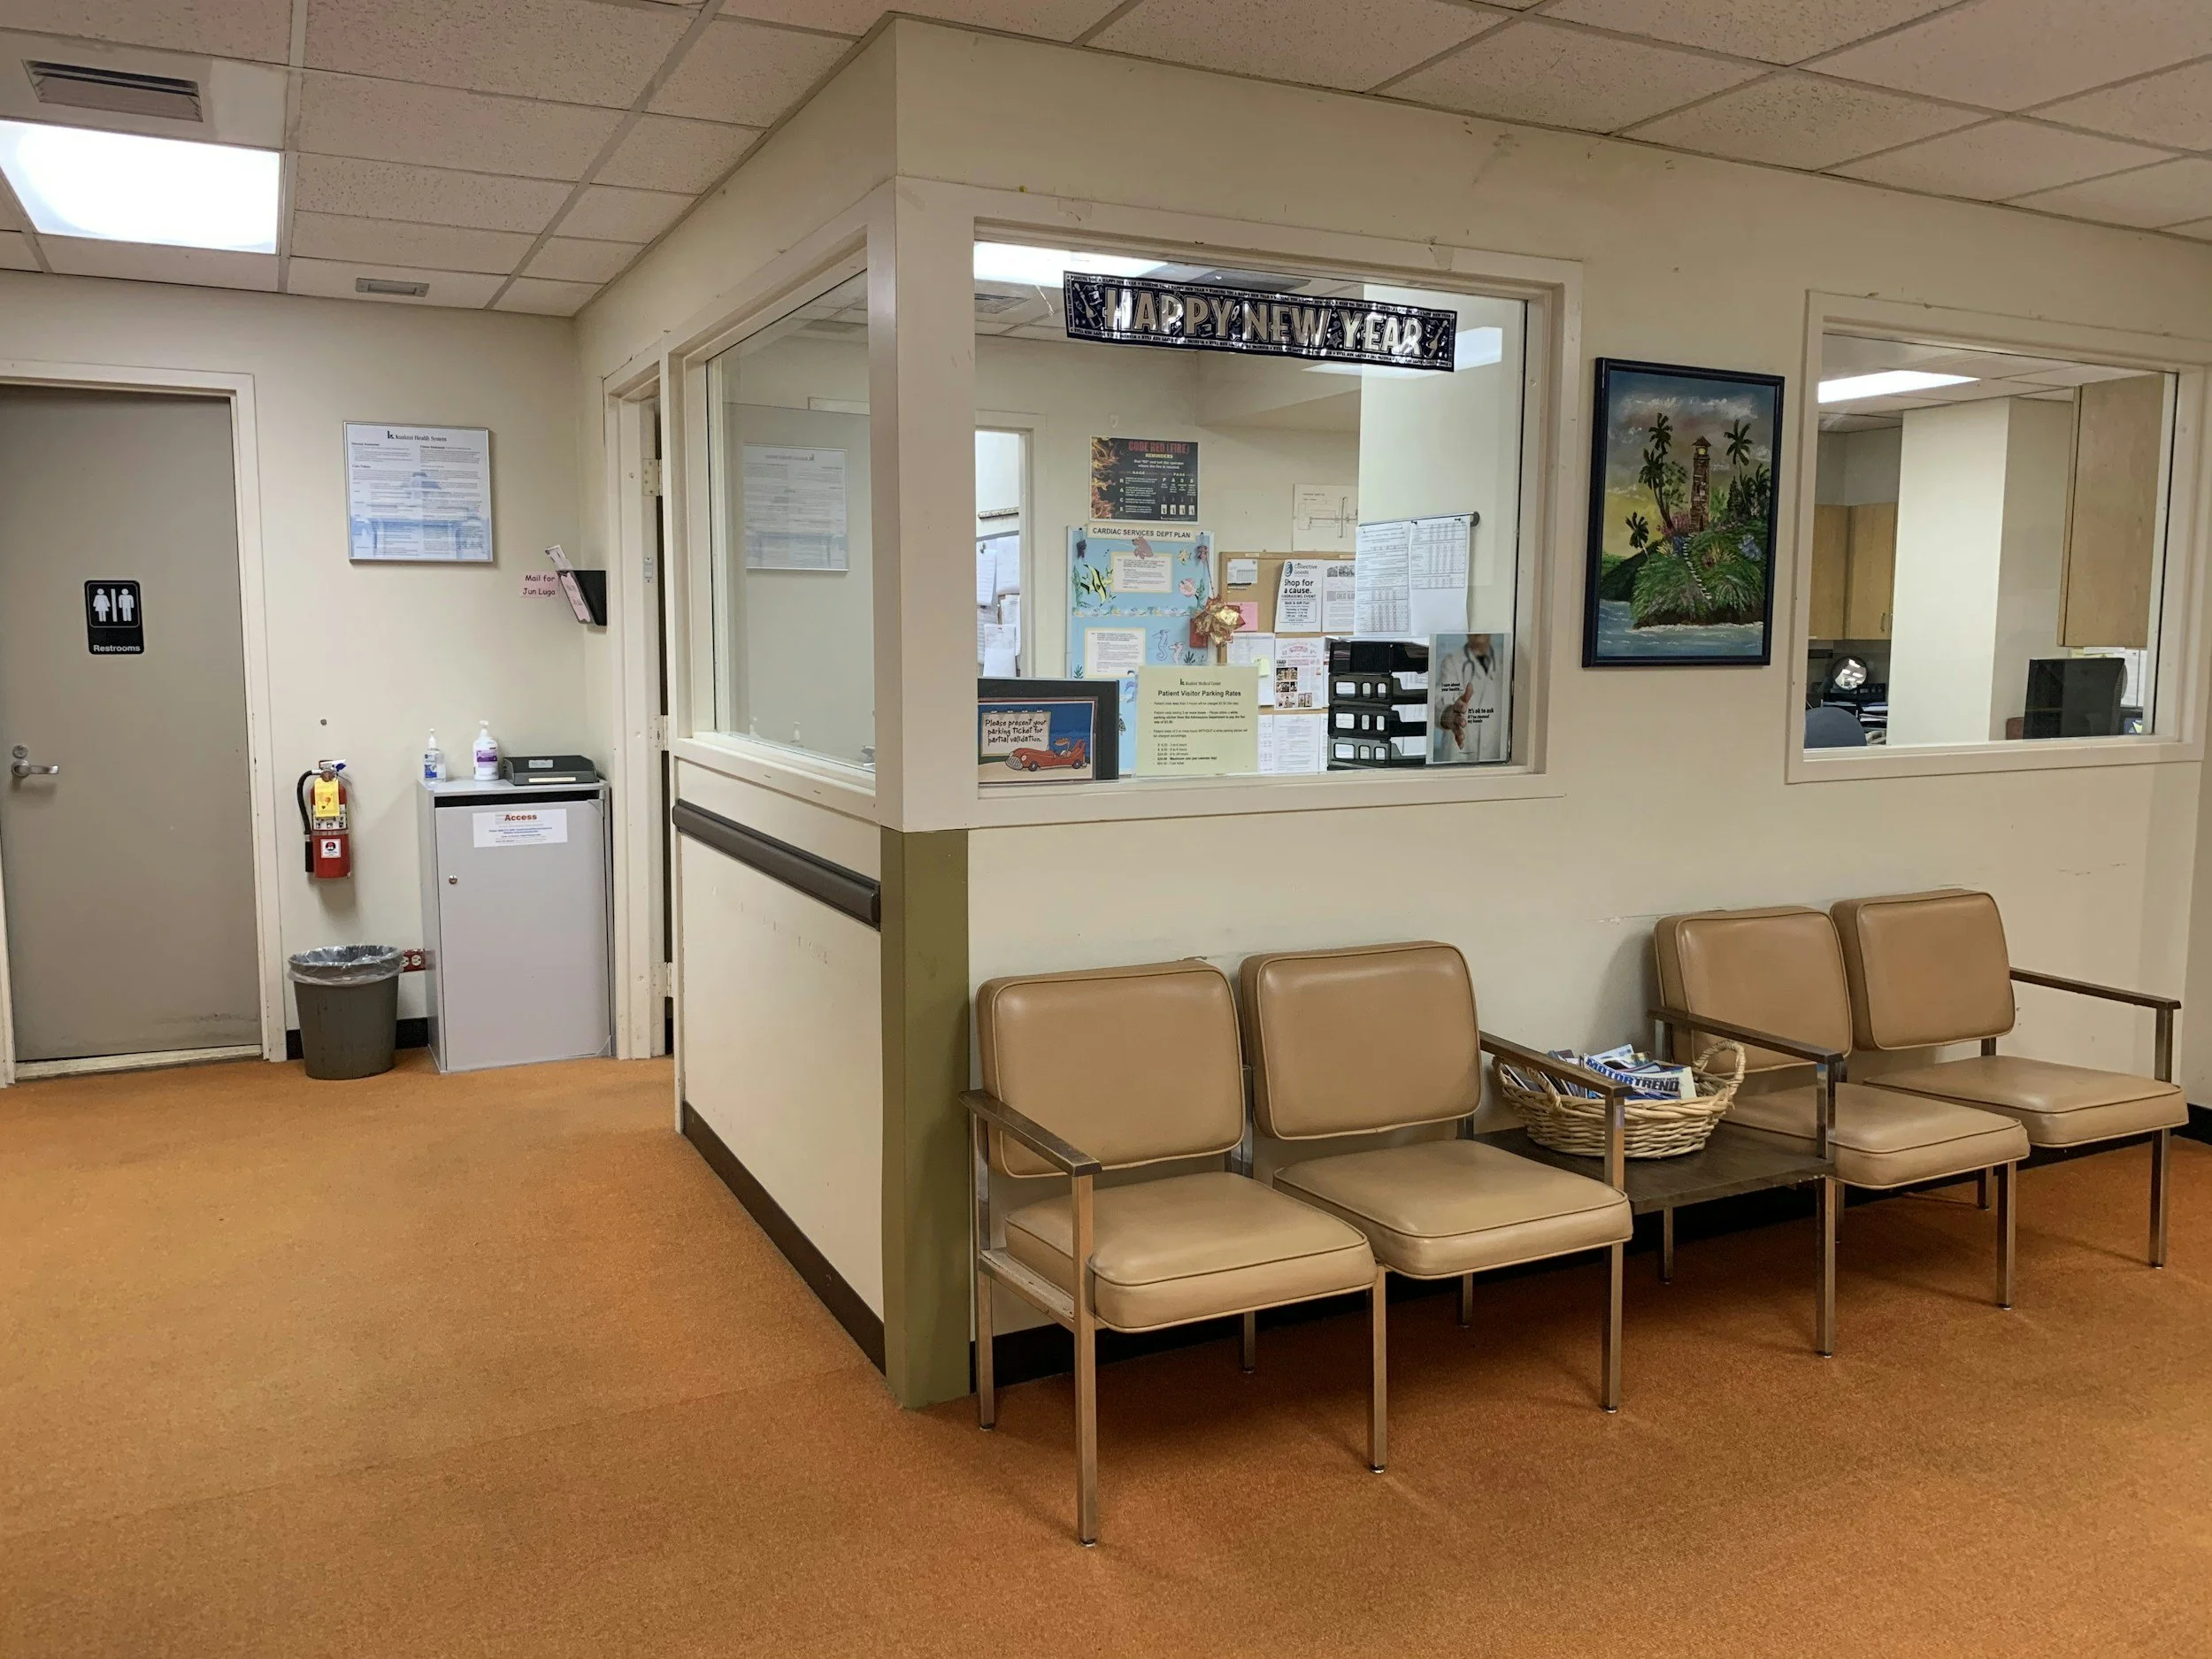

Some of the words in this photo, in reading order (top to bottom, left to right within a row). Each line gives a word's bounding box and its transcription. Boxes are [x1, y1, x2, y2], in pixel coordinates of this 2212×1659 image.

[1102, 288, 1236, 339] HAPPY
[1242, 300, 1332, 347] NEW
[1338, 310, 1424, 357] YEAR
[1128, 442, 1148, 452] CODE
[1149, 442, 1165, 453] RED
[1284, 579, 1300, 588] Shop
[1008, 718, 1032, 728] present
[987, 727, 1010, 737] parking
[987, 735, 1009, 746] partial
